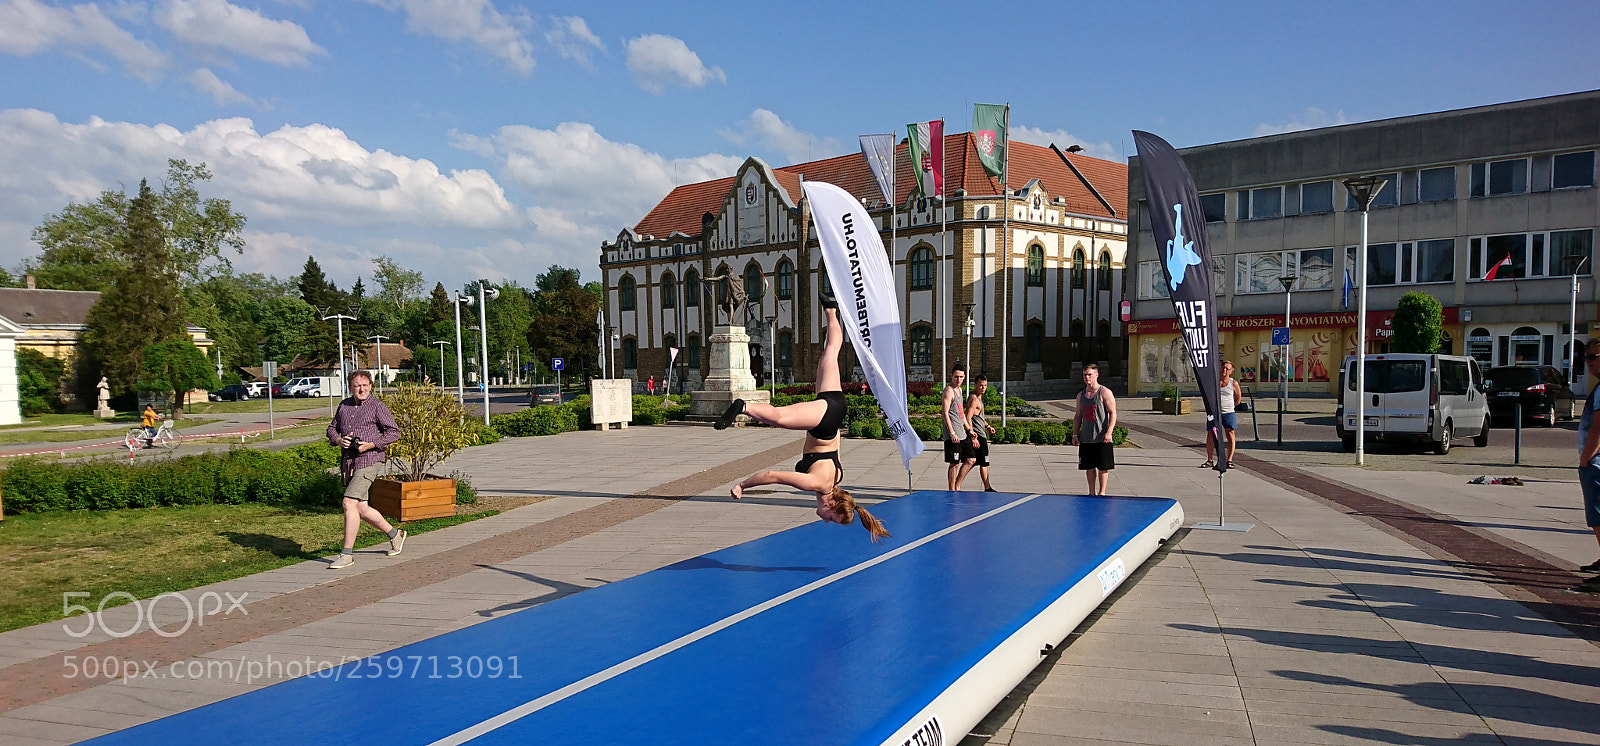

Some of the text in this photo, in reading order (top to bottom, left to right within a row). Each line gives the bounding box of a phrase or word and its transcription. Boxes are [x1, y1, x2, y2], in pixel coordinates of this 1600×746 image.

[1217, 316, 1275, 328] PÍR-ÍRÓSZER
[1289, 312, 1359, 326] NYOMTATVÁN
[1273, 329, 1280, 338] P
[554, 359, 562, 369] P
